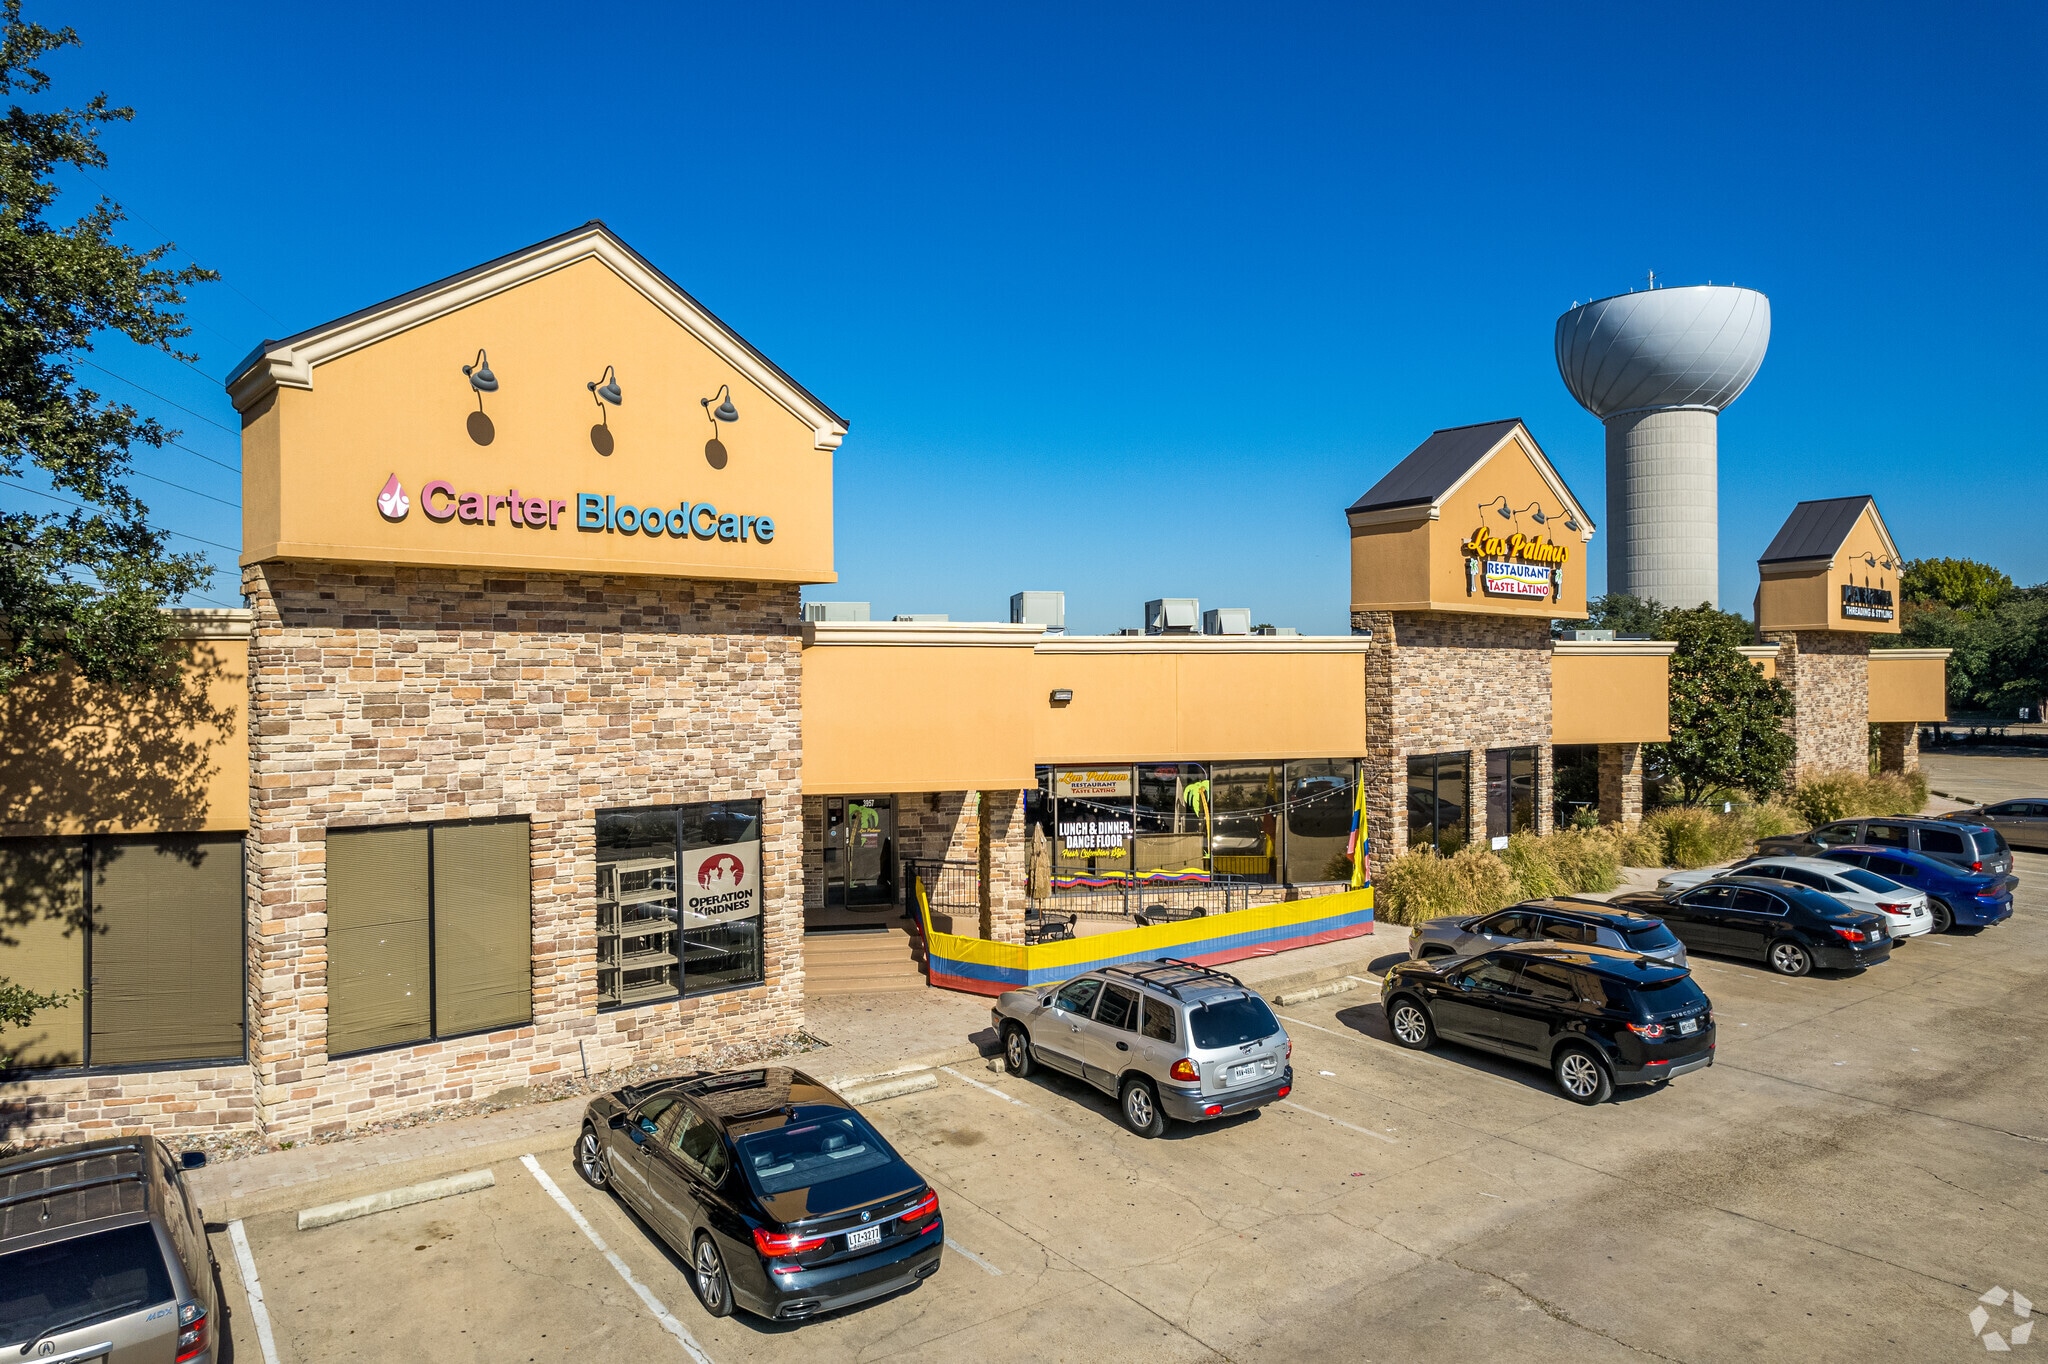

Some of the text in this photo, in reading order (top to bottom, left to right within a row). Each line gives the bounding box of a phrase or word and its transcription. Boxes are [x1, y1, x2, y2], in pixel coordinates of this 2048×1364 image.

[420, 479, 775, 542] Carter BloodCare
[1468, 526, 1569, 563] Las Palmas
[1487, 562, 1550, 579] RESTAURANT
[1488, 579, 1549, 595] TASTE LATINO
[1846, 605, 1893, 619] THREADING & STYLING
[1059, 771, 1128, 785] Las Palmas
[863, 799, 875, 807] 3957
[1059, 821, 1130, 836] LUNCH & DINNER
[1066, 834, 1123, 849] DANCE FLOOR
[689, 889, 752, 908] OPERATION
[694, 900, 750, 918] KINDNESS
[145, 1306, 173, 1322] MDX
